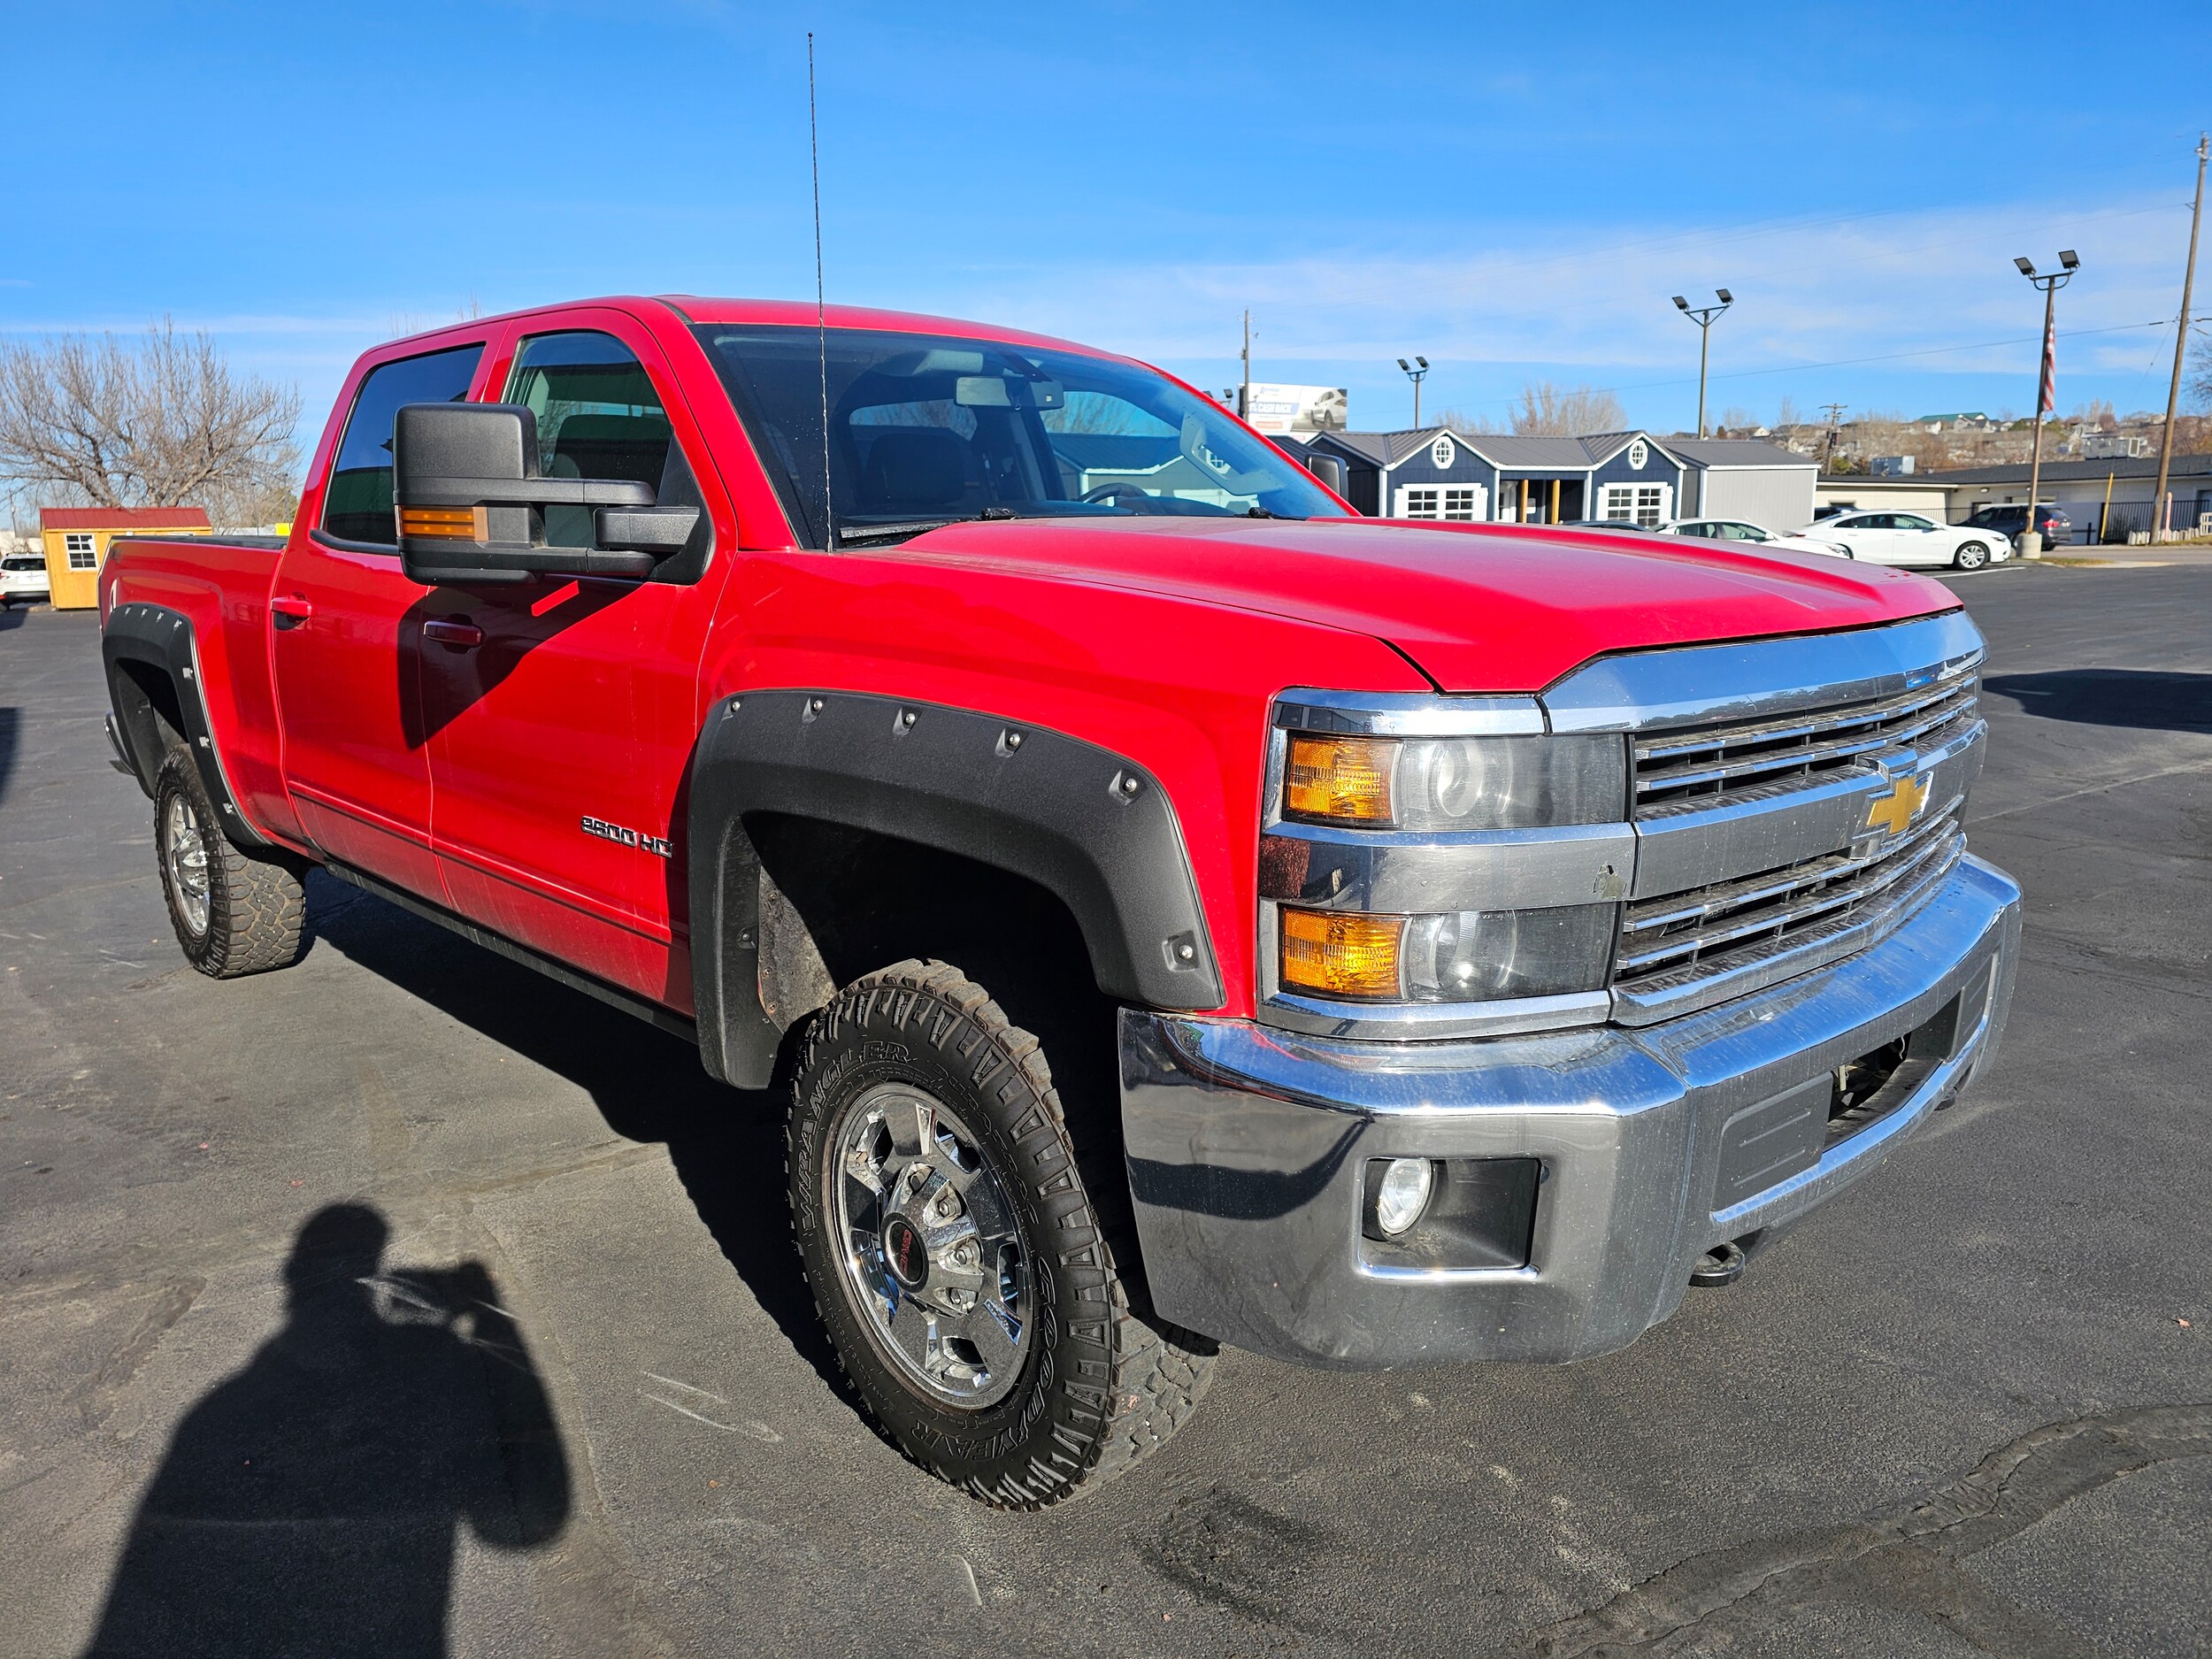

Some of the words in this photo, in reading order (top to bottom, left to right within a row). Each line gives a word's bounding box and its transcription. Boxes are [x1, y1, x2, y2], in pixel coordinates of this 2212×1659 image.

[580, 815, 638, 848] 2500
[798, 1041, 912, 1231] WRANGLER
[910, 1256, 1057, 1461] GOODYEAR
